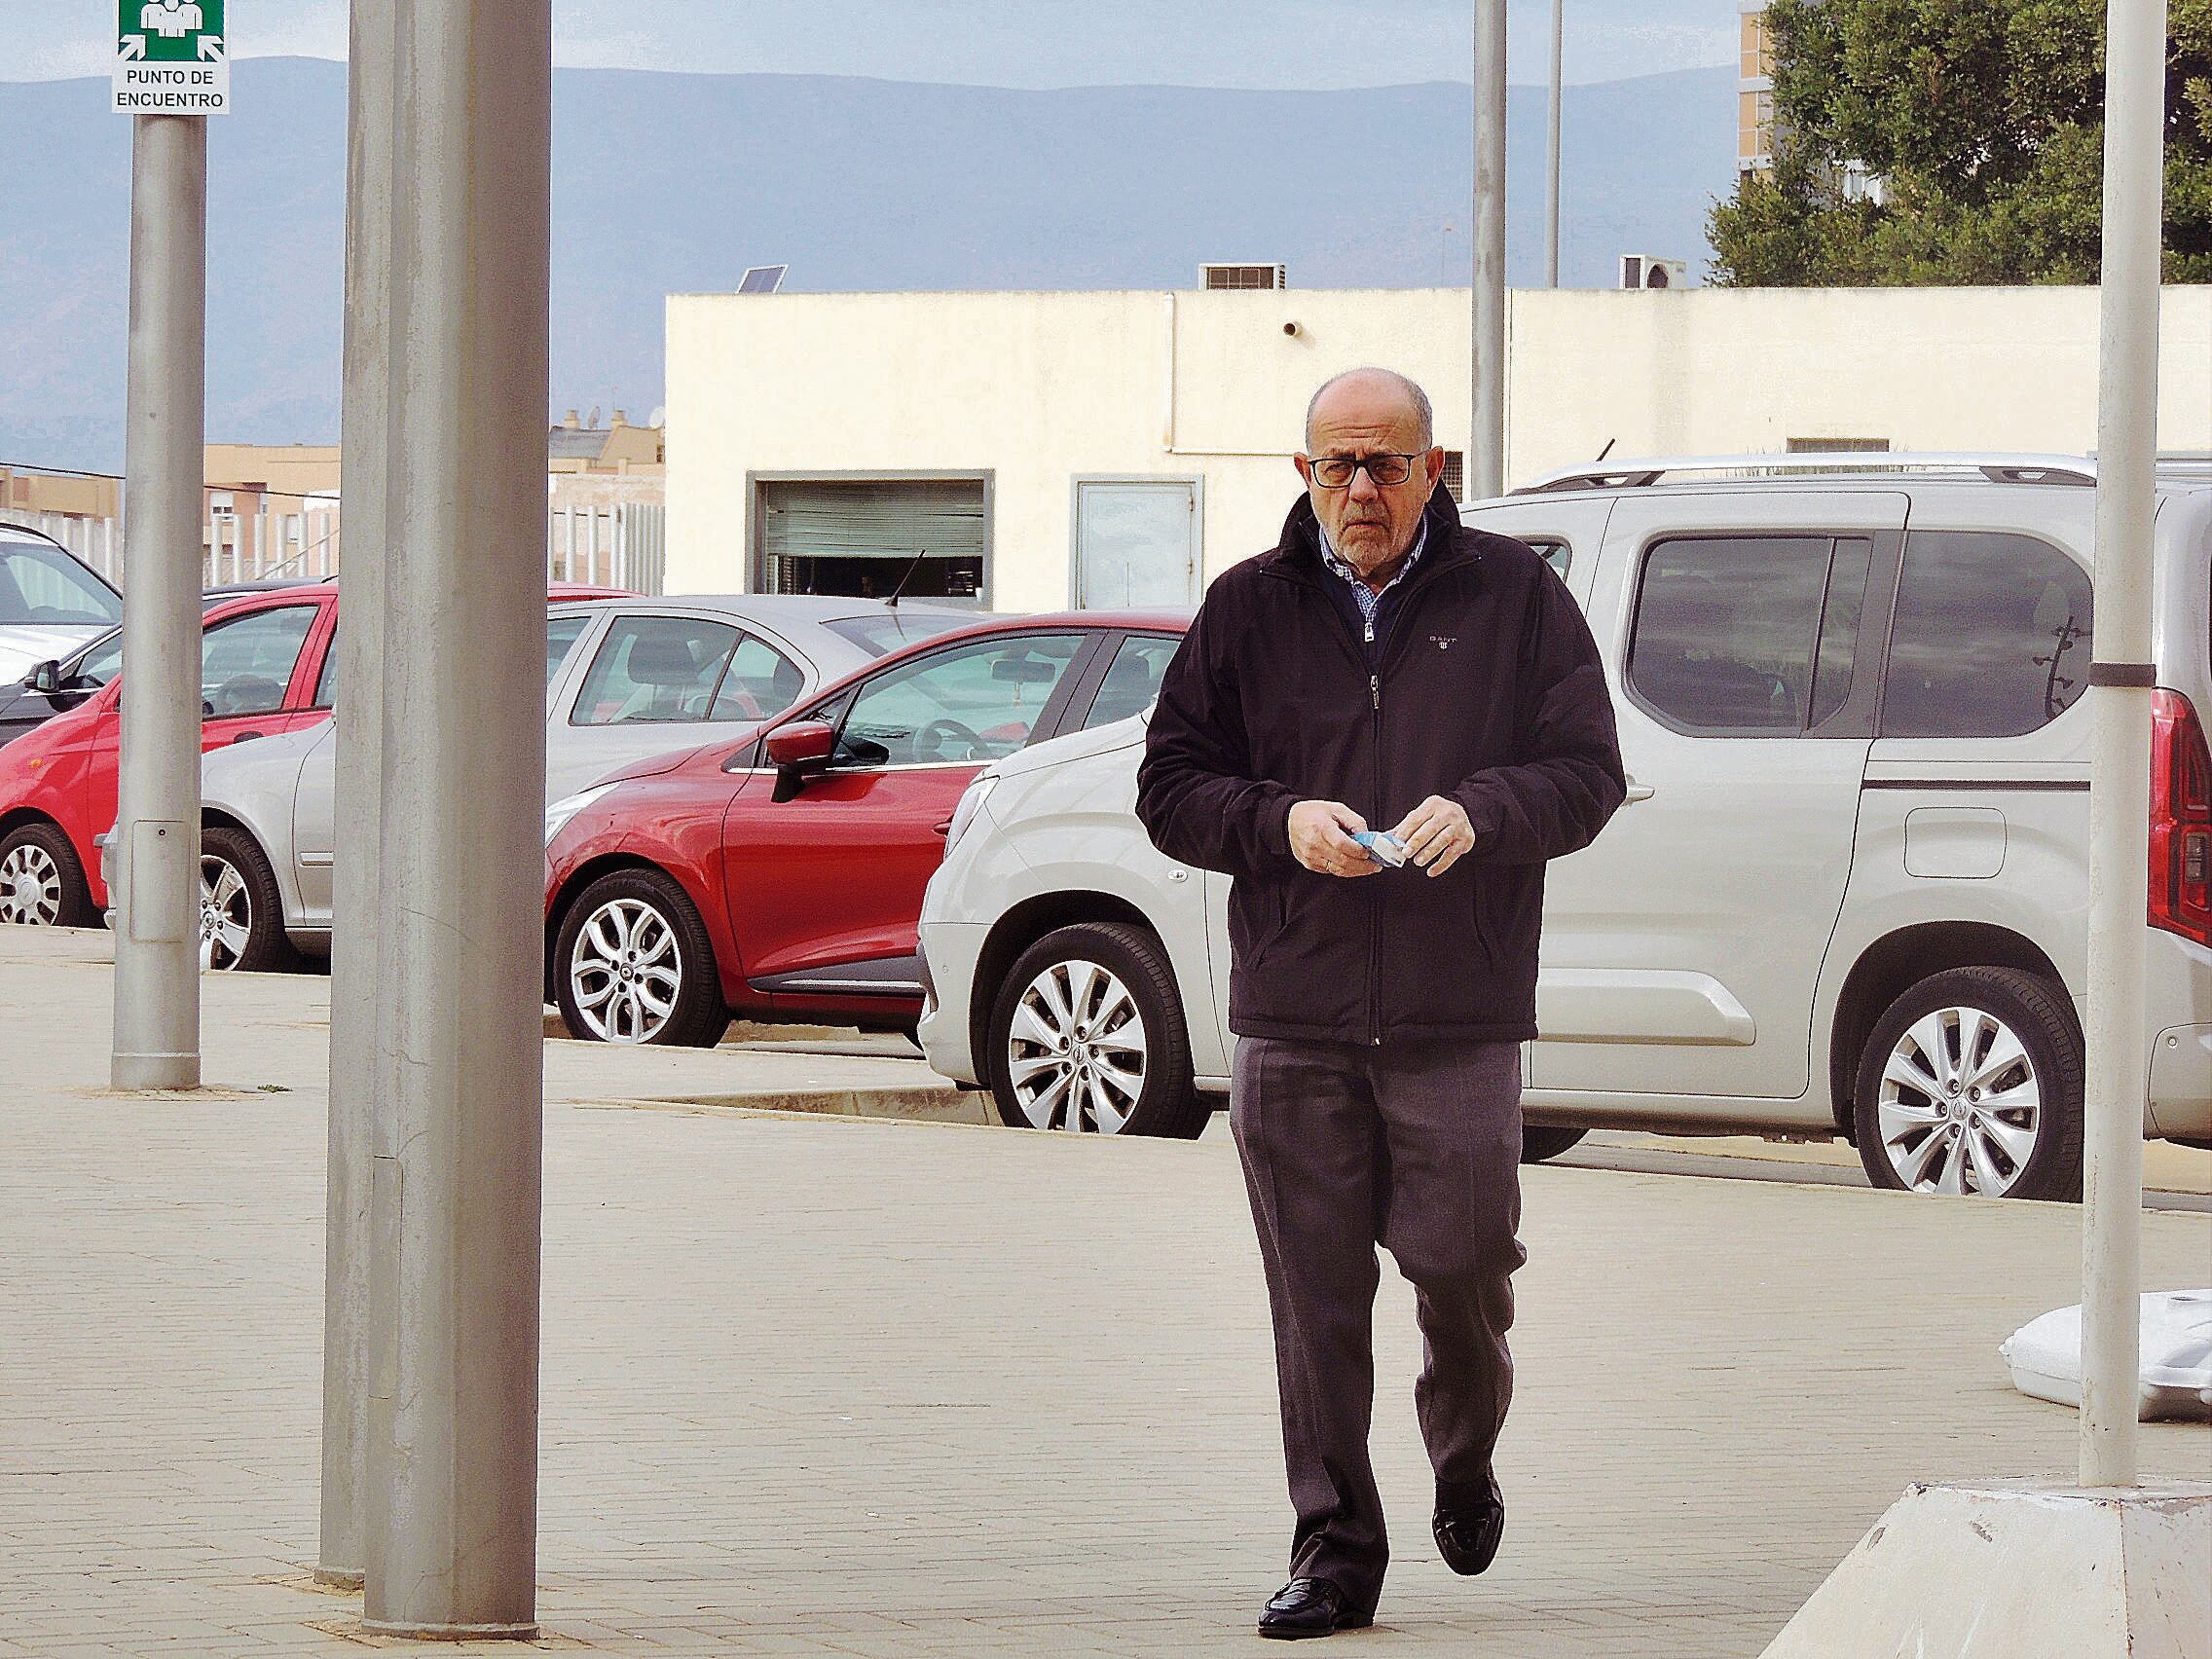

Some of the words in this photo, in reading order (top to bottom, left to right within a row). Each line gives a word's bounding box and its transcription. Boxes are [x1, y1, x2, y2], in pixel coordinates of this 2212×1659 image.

[127, 70, 185, 84] PUNTO
[191, 71, 213, 85] DE
[117, 92, 223, 107] ENCUENTRO
